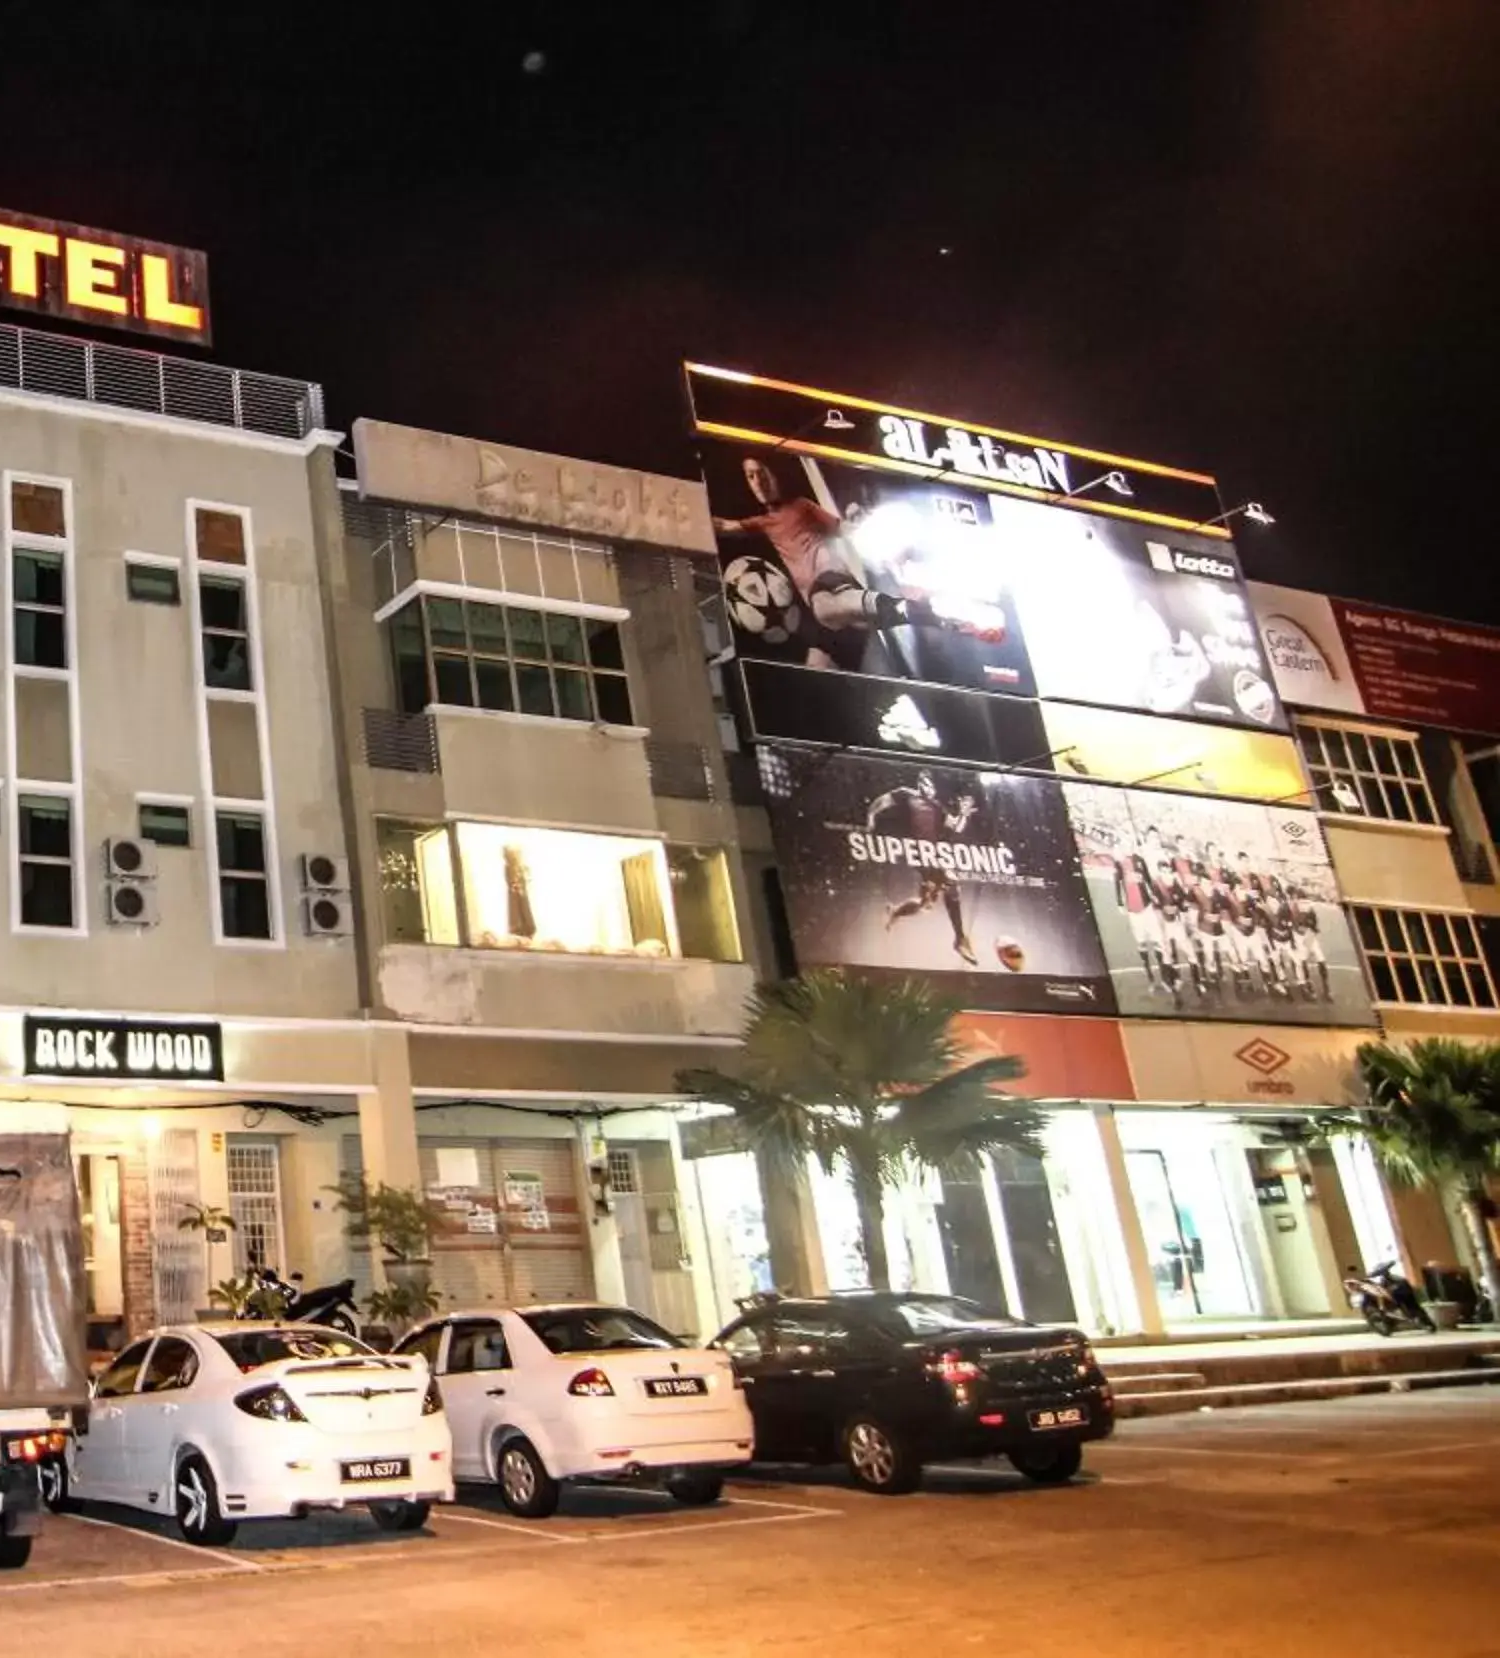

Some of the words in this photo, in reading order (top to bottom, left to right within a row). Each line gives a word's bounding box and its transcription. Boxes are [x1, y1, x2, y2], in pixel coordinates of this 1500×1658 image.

[1266, 629, 1305, 653] Great
[1270, 647, 1326, 673] Eastern
[849, 832, 1016, 874] SUPERSONIC
[35, 1028, 118, 1069] ROCK
[127, 1031, 213, 1071] WOOD
